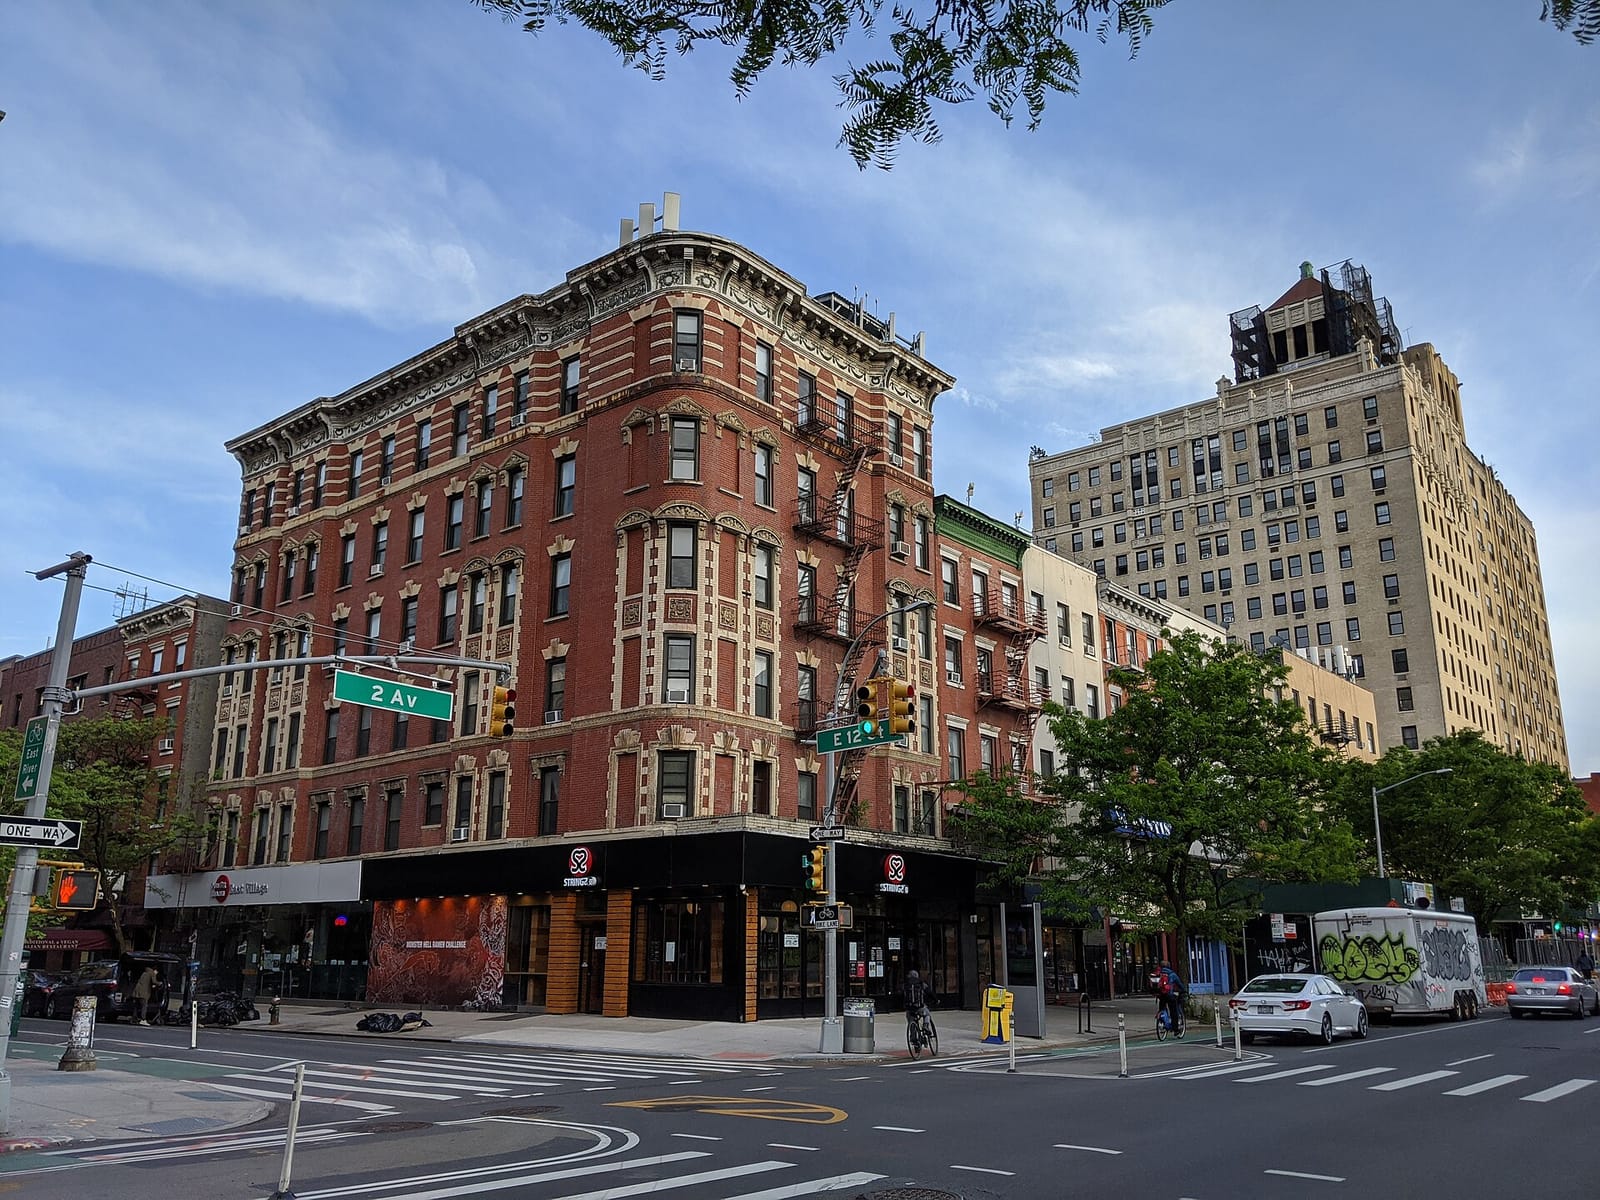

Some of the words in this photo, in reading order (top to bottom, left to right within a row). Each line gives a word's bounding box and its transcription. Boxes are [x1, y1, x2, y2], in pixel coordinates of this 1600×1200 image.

[371, 685, 384, 702] 2
[390, 689, 418, 708] Av
[834, 732, 842, 747] E
[847, 730, 862, 745] 12
[26, 748, 39, 760] East
[22, 763, 38, 775] River
[6, 825, 32, 837] ONE
[42, 827, 68, 840] WAY
[245, 881, 269, 896] Village
